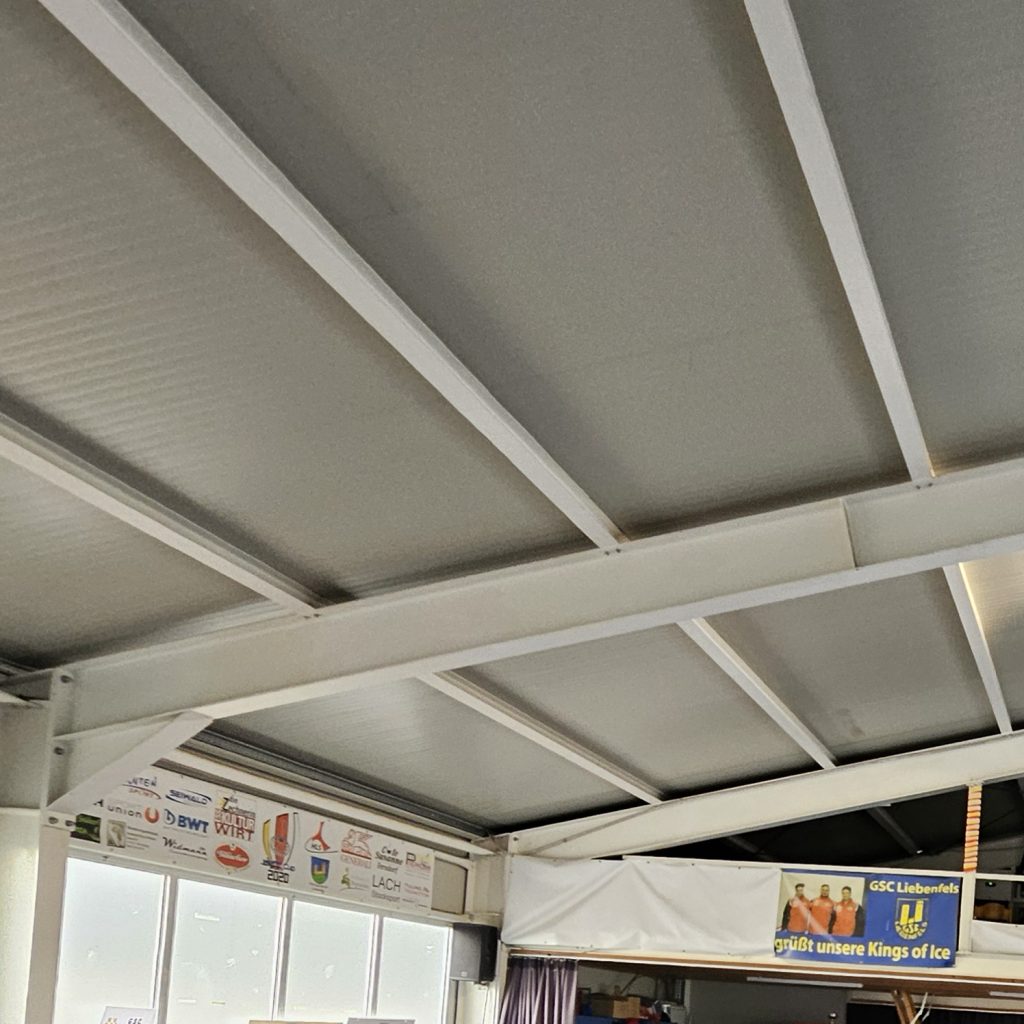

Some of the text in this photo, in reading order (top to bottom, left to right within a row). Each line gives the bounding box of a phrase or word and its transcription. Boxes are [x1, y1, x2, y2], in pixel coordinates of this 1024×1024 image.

[177, 815, 209, 834] BWT
[214, 821, 255, 842] WIRT
[267, 869, 289, 883] 2020
[372, 874, 402, 893] LACH
[869, 880, 960, 895] GSC Liebenfels
[774, 937, 951, 961] grüßt unsere Kings of Ice
